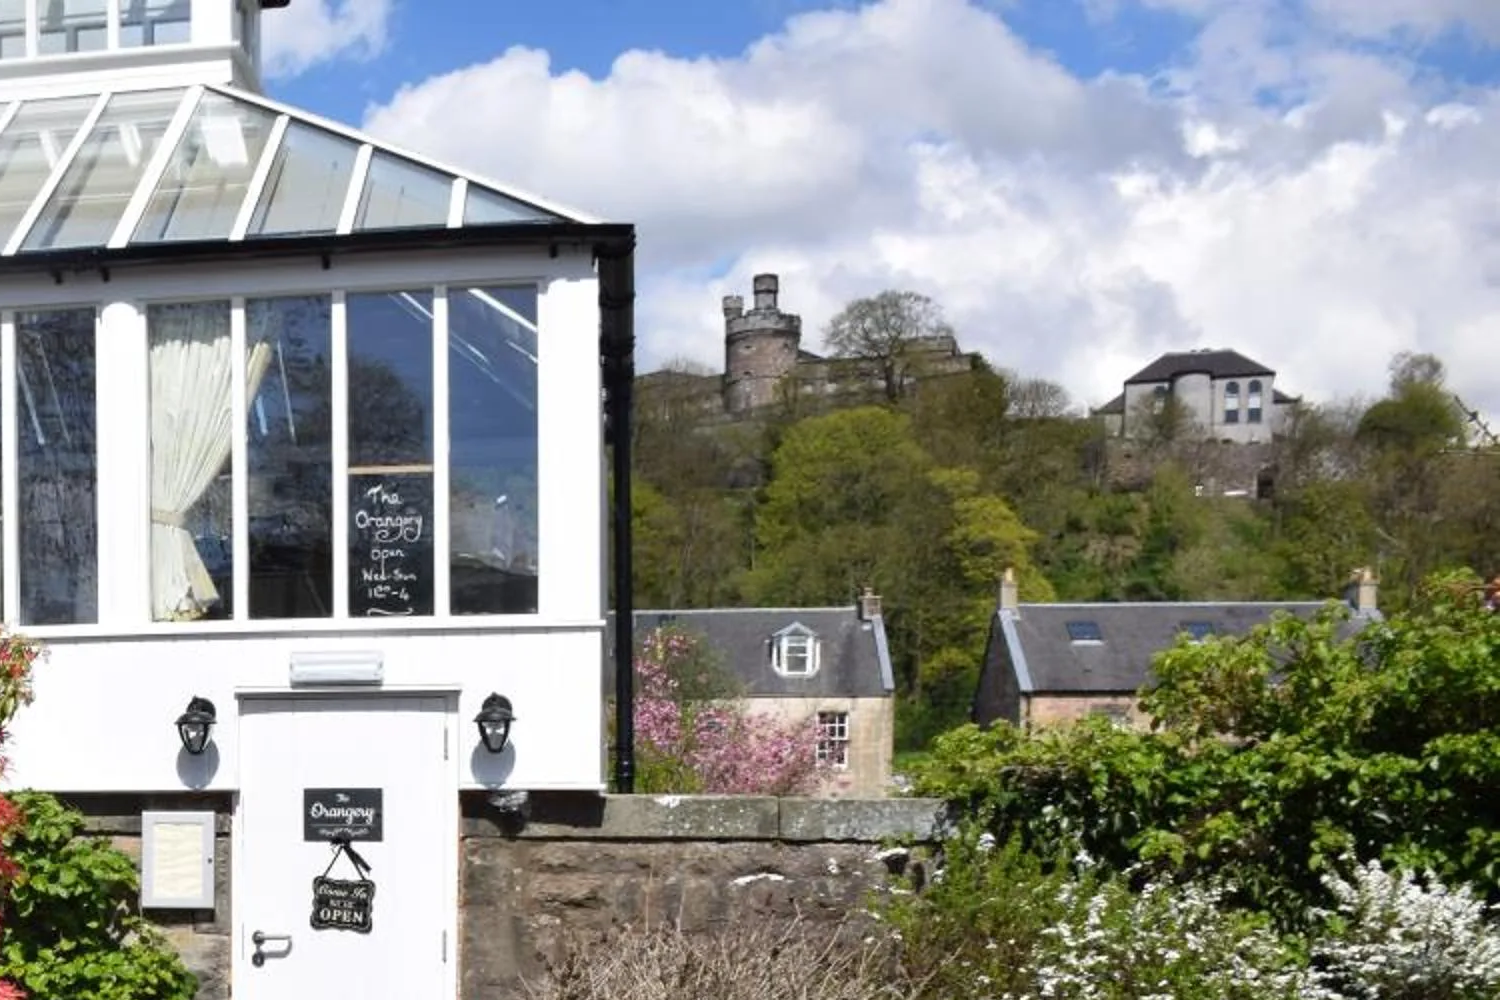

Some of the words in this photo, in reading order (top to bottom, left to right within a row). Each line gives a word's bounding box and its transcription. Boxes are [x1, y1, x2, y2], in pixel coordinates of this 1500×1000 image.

[366, 483, 403, 505] The
[355, 509, 423, 543] Orangery
[310, 802, 374, 825] Orangery
[319, 907, 364, 924] OPEN
